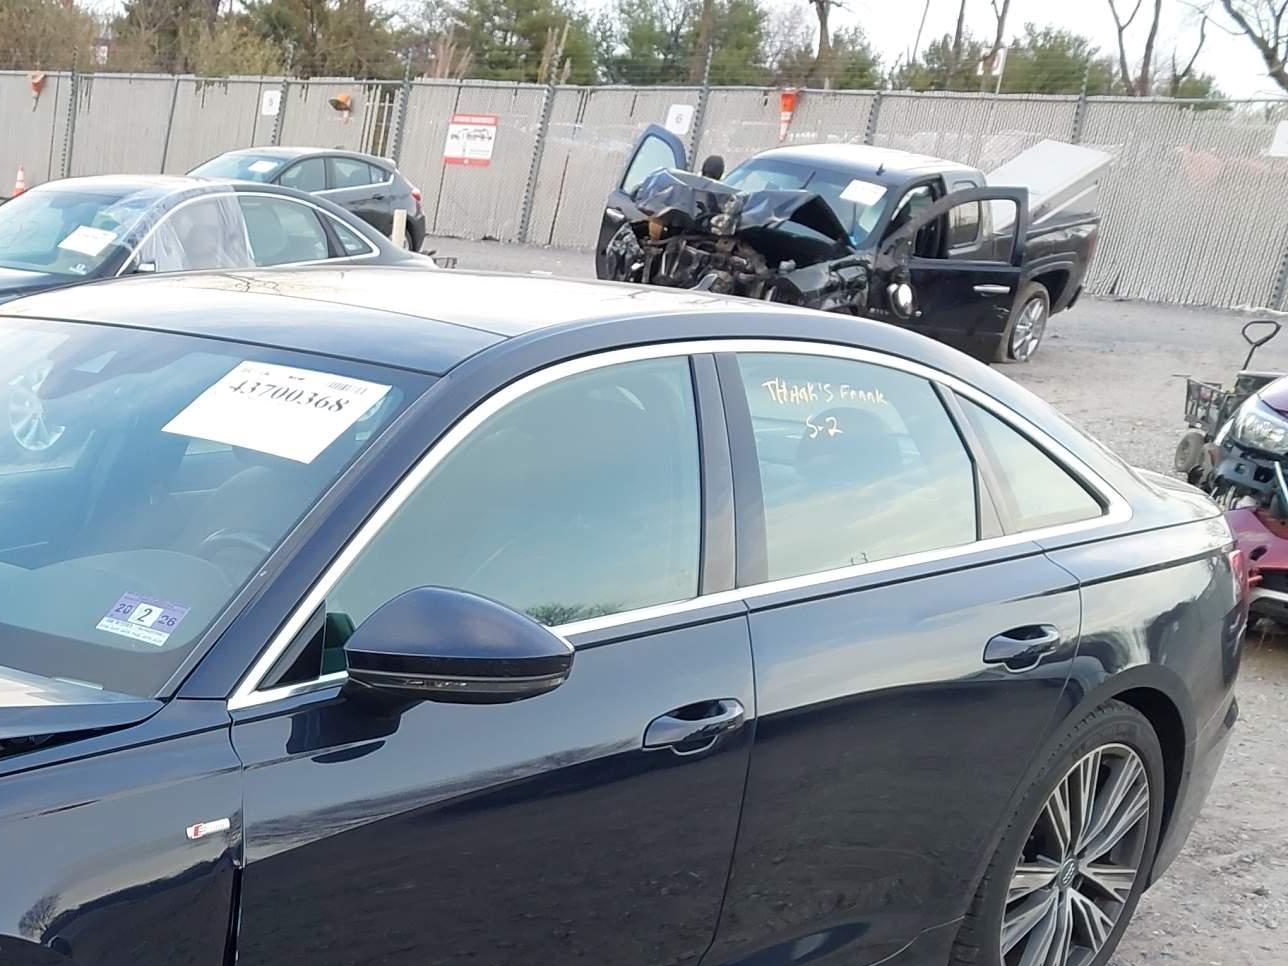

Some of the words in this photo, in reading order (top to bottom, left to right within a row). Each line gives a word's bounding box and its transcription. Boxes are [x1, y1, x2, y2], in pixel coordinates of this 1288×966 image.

[675, 113, 684, 124] 6
[229, 380, 350, 412] 43700368
[115, 602, 134, 615] 20
[137, 607, 153, 622] 2
[158, 615, 177, 627] 26
